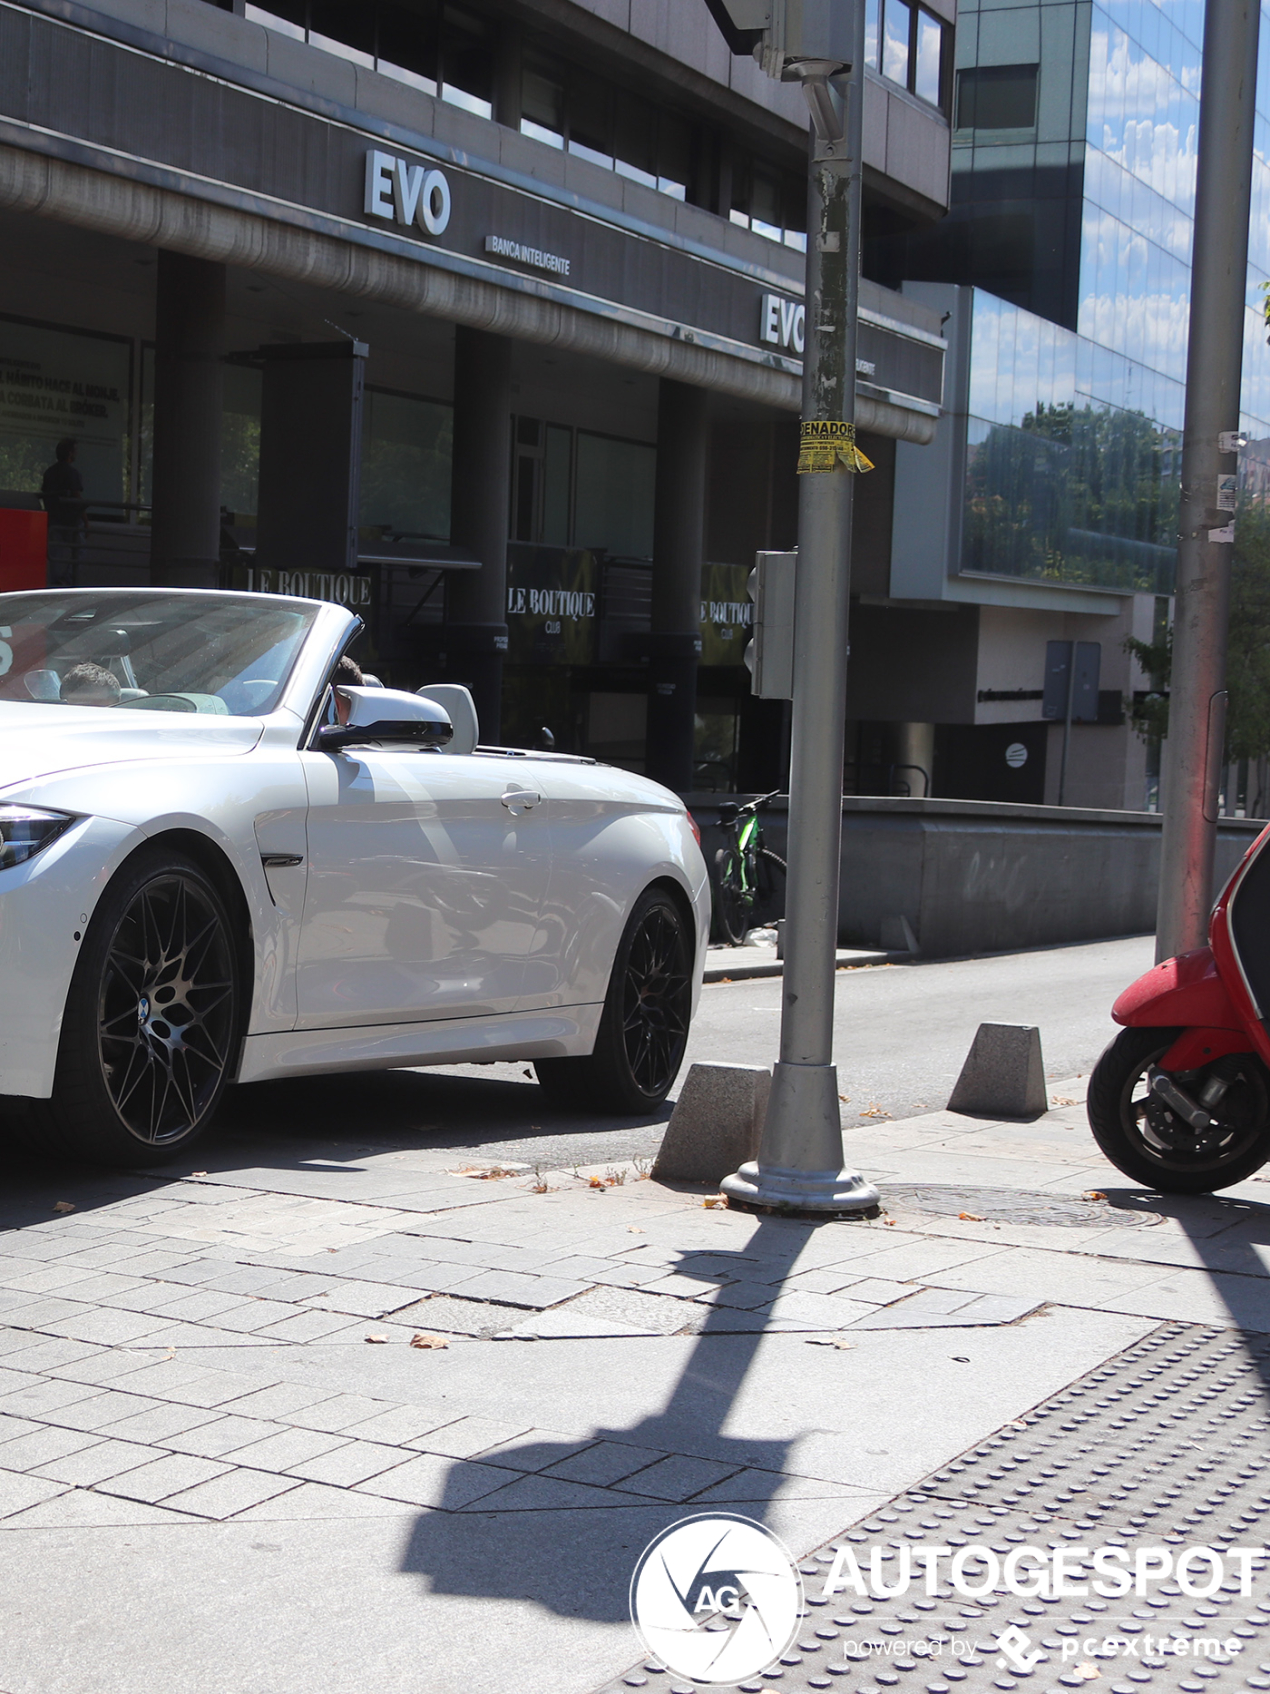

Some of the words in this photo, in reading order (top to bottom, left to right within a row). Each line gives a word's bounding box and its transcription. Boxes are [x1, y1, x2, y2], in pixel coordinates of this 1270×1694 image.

[364, 149, 452, 236] EVO
[485, 235, 520, 257] BANCA
[521, 244, 571, 276] INTELIGENTE
[7, 390, 55, 411] CORBATA
[56, 397, 69, 413] AL
[45, 376, 71, 395] HACE
[72, 381, 85, 397] AL
[507, 587, 526, 614] LE
[529, 588, 596, 622] BOUTIQUE
[710, 601, 754, 629] BOUTIQU
